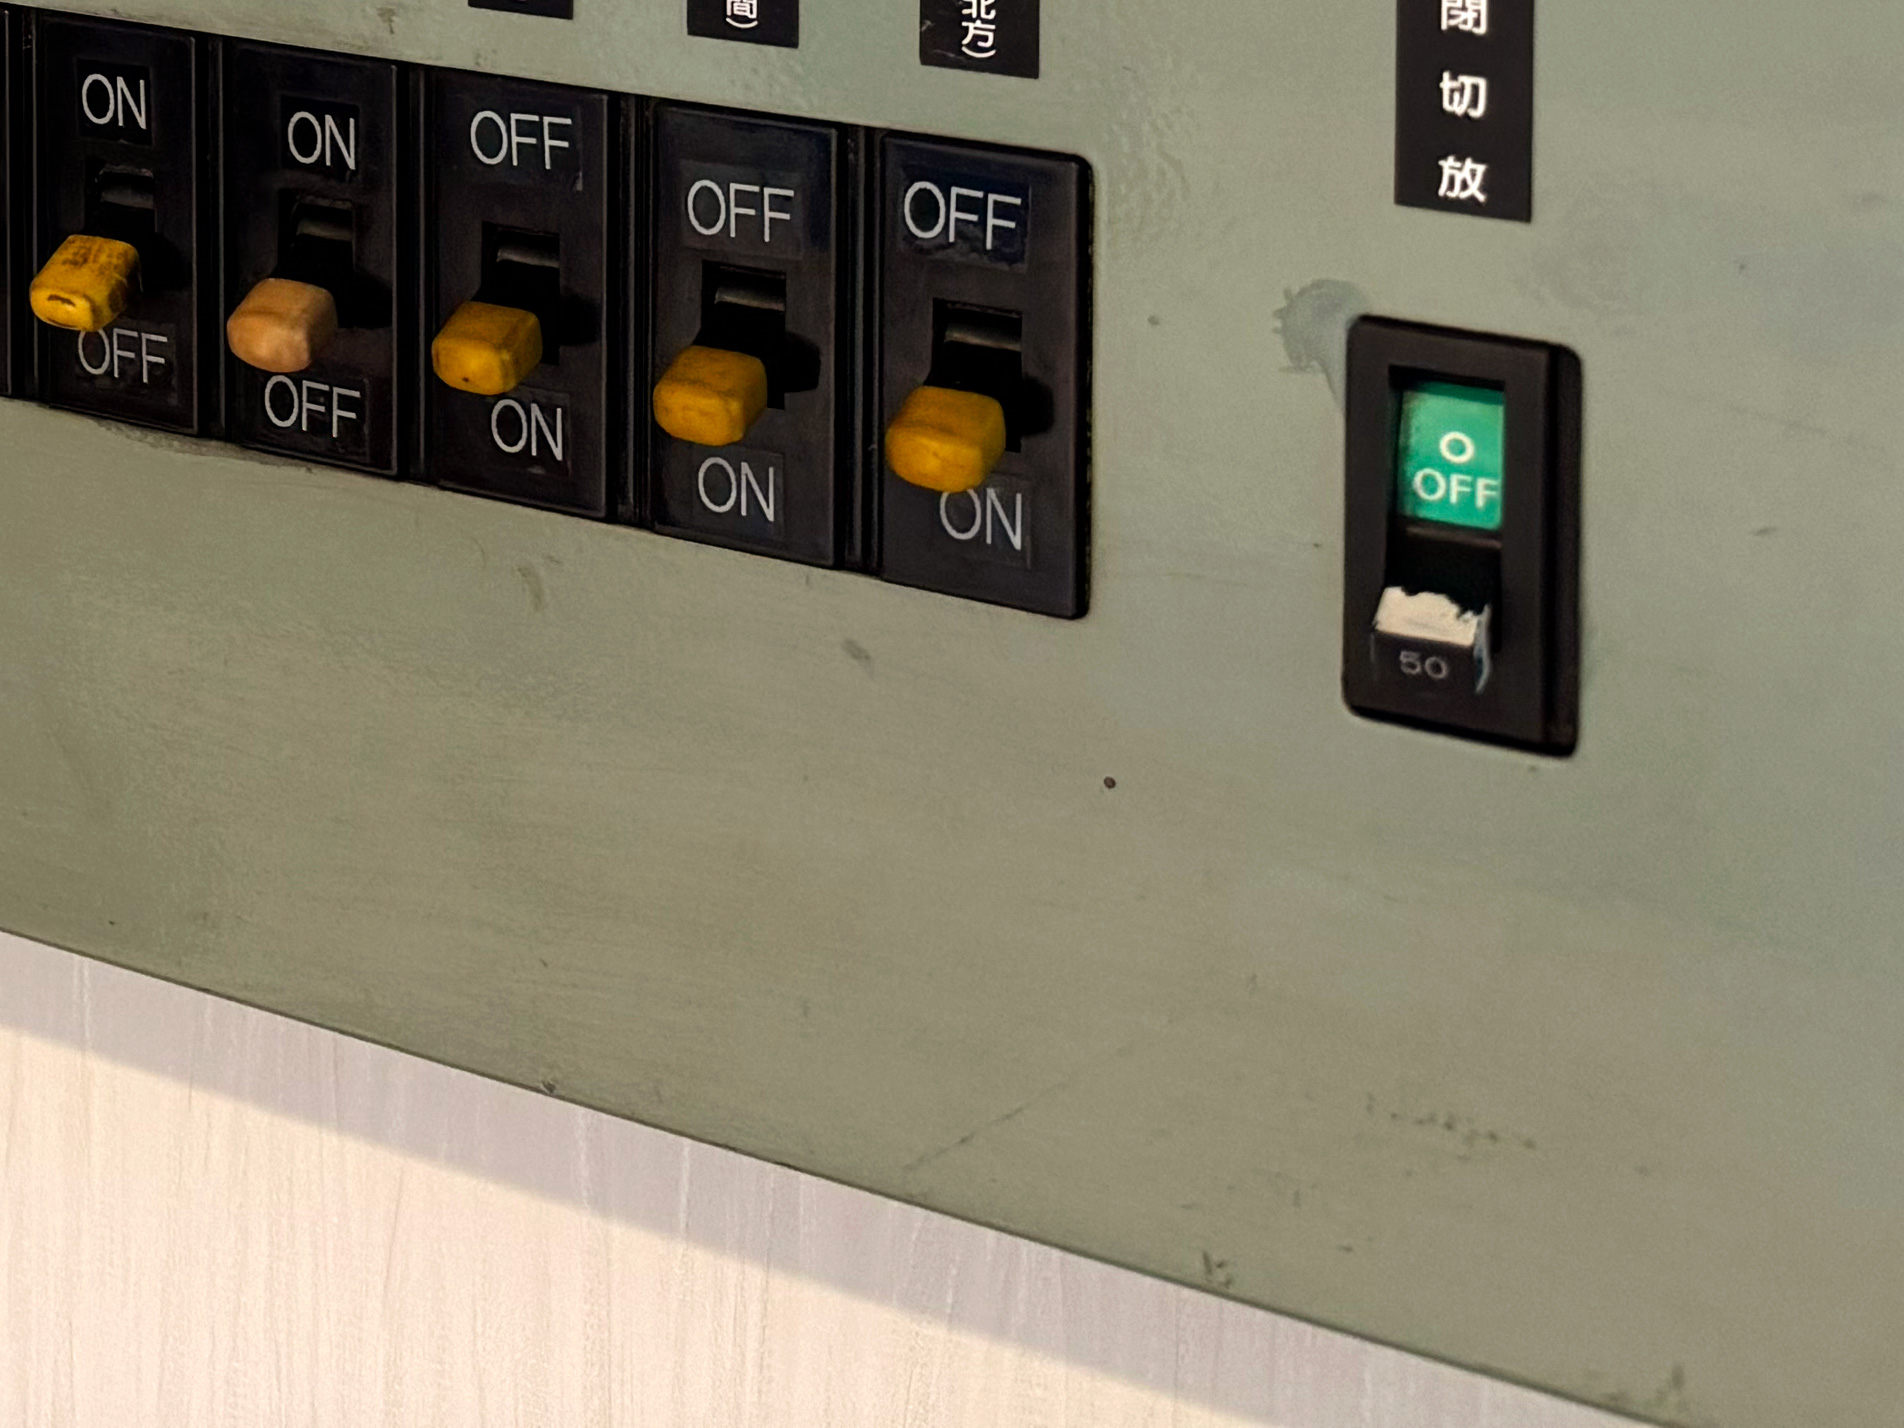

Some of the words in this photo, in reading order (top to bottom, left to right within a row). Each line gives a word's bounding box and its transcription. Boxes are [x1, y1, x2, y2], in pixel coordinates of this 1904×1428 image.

[81, 72, 147, 130] ON
[287, 111, 357, 171] ON
[470, 108, 572, 171] OFF
[686, 178, 795, 244] OFF
[902, 179, 1022, 252] OFF
[77, 325, 169, 384] OFF
[264, 373, 361, 440] OFF
[490, 397, 564, 462] ON
[697, 456, 775, 524] ON
[938, 485, 1023, 552] ON
[1412, 467, 1500, 510] OFF
[1398, 649, 1449, 682] 50
